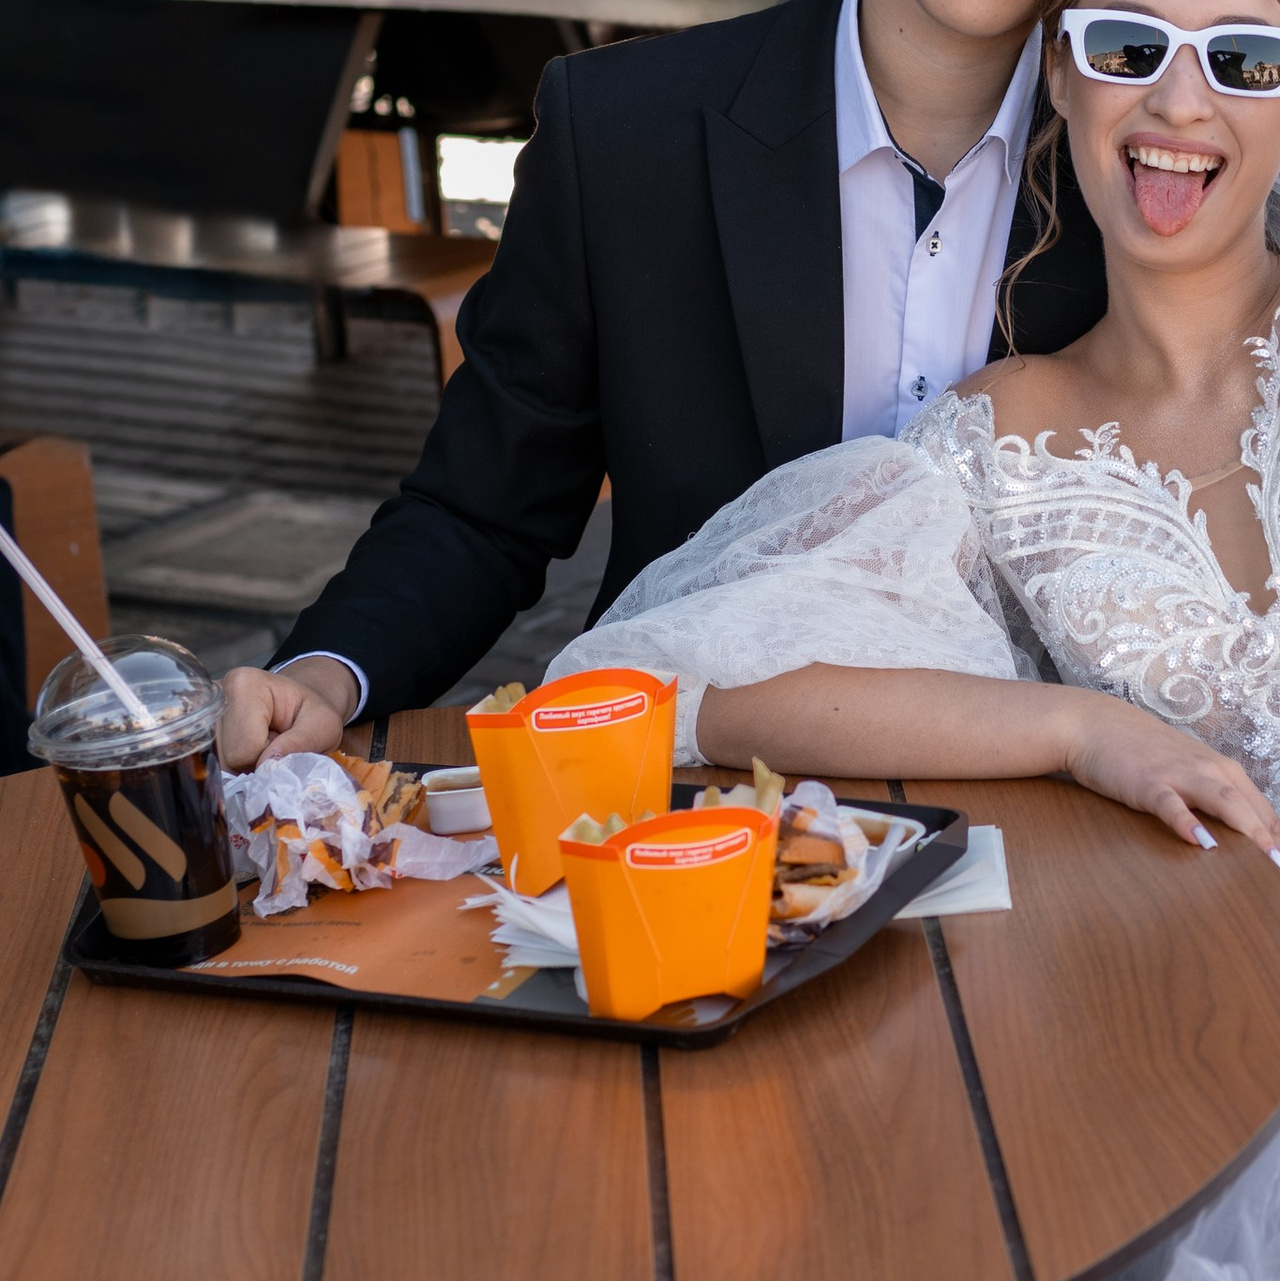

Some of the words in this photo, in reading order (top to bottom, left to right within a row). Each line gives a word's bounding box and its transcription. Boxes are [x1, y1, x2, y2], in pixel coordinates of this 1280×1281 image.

[231, 958, 275, 969] точку
[276, 958, 287, 966] с
[286, 956, 360, 976] работой
